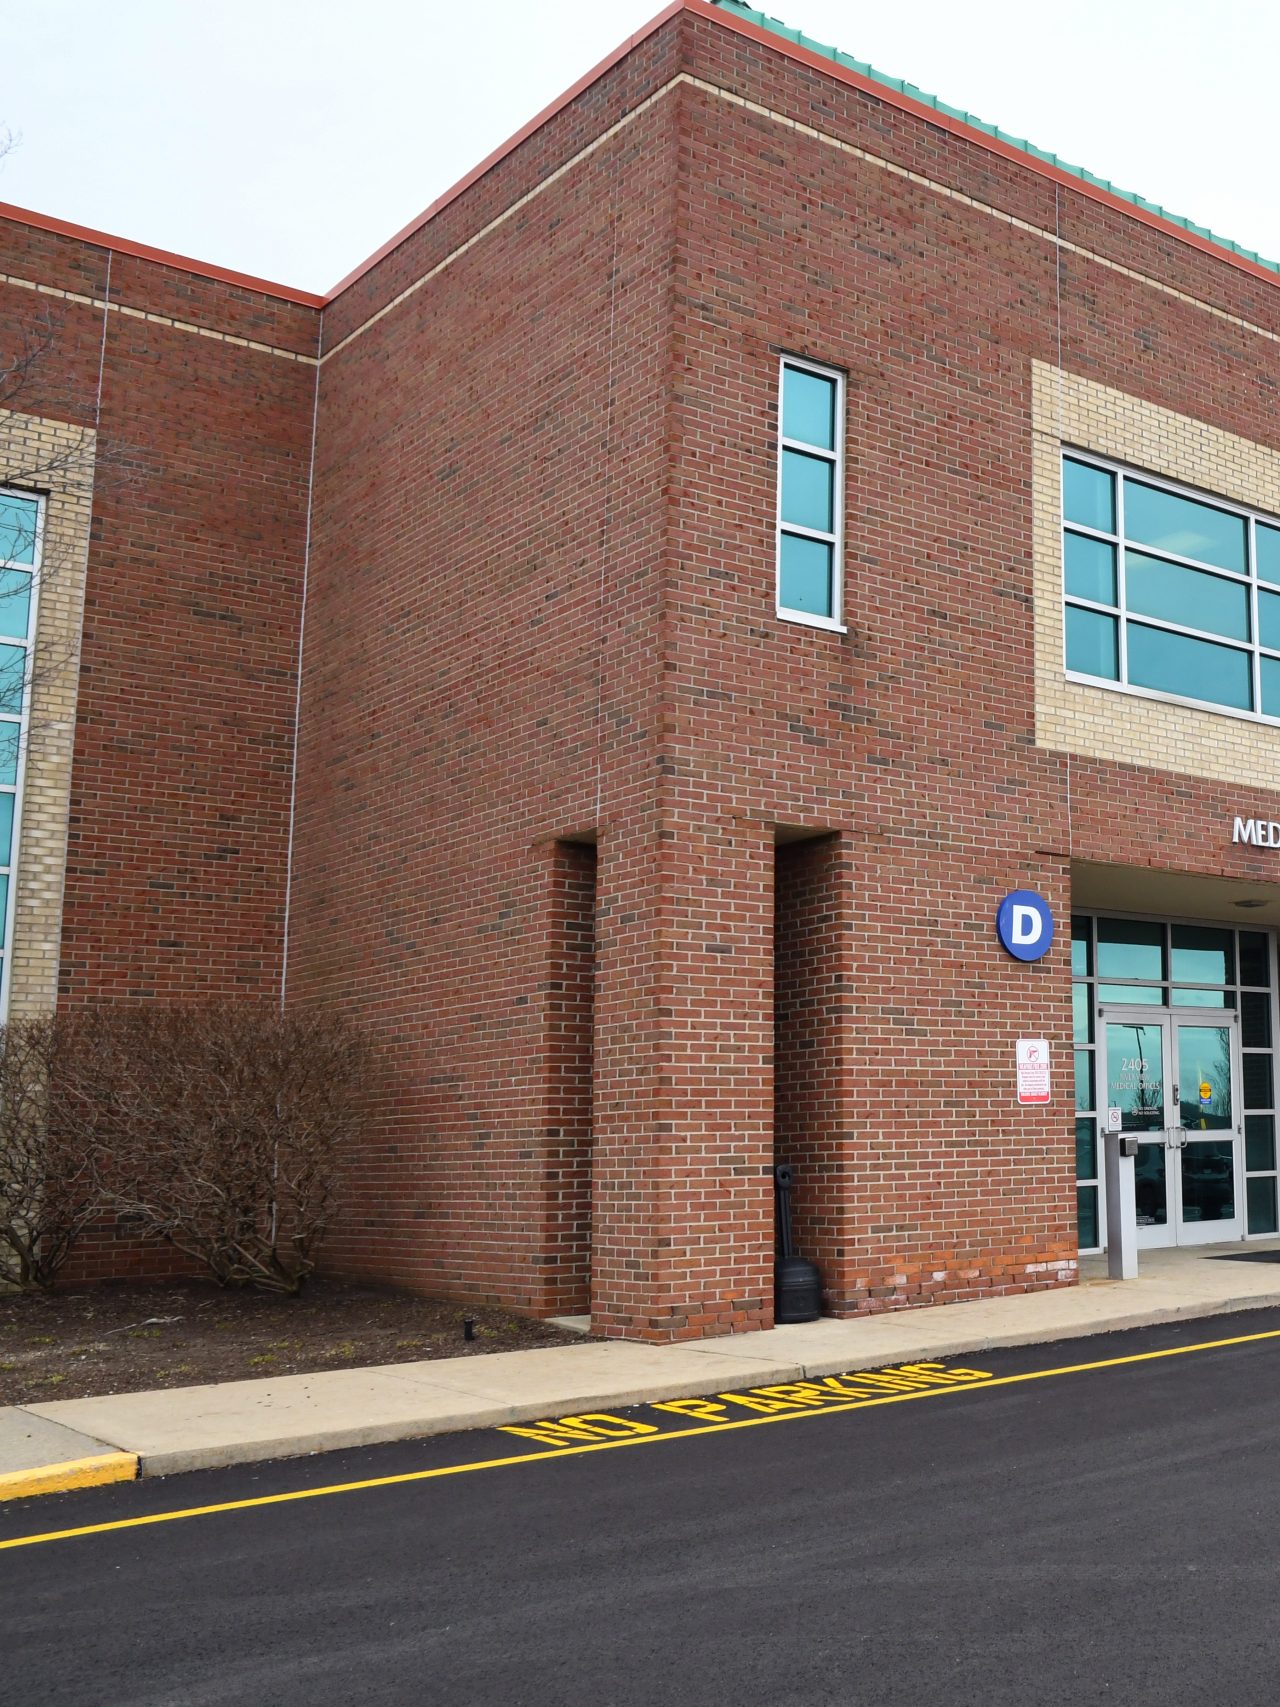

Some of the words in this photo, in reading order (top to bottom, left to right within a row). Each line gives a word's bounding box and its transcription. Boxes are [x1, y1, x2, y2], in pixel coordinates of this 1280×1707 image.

[1011, 904, 1042, 945] D
[1121, 1057, 1149, 1071] 2405
[1111, 1082, 1137, 1090] MEDICAL
[496, 1413, 660, 1447] NO
[651, 1362, 995, 1422] PARKING
